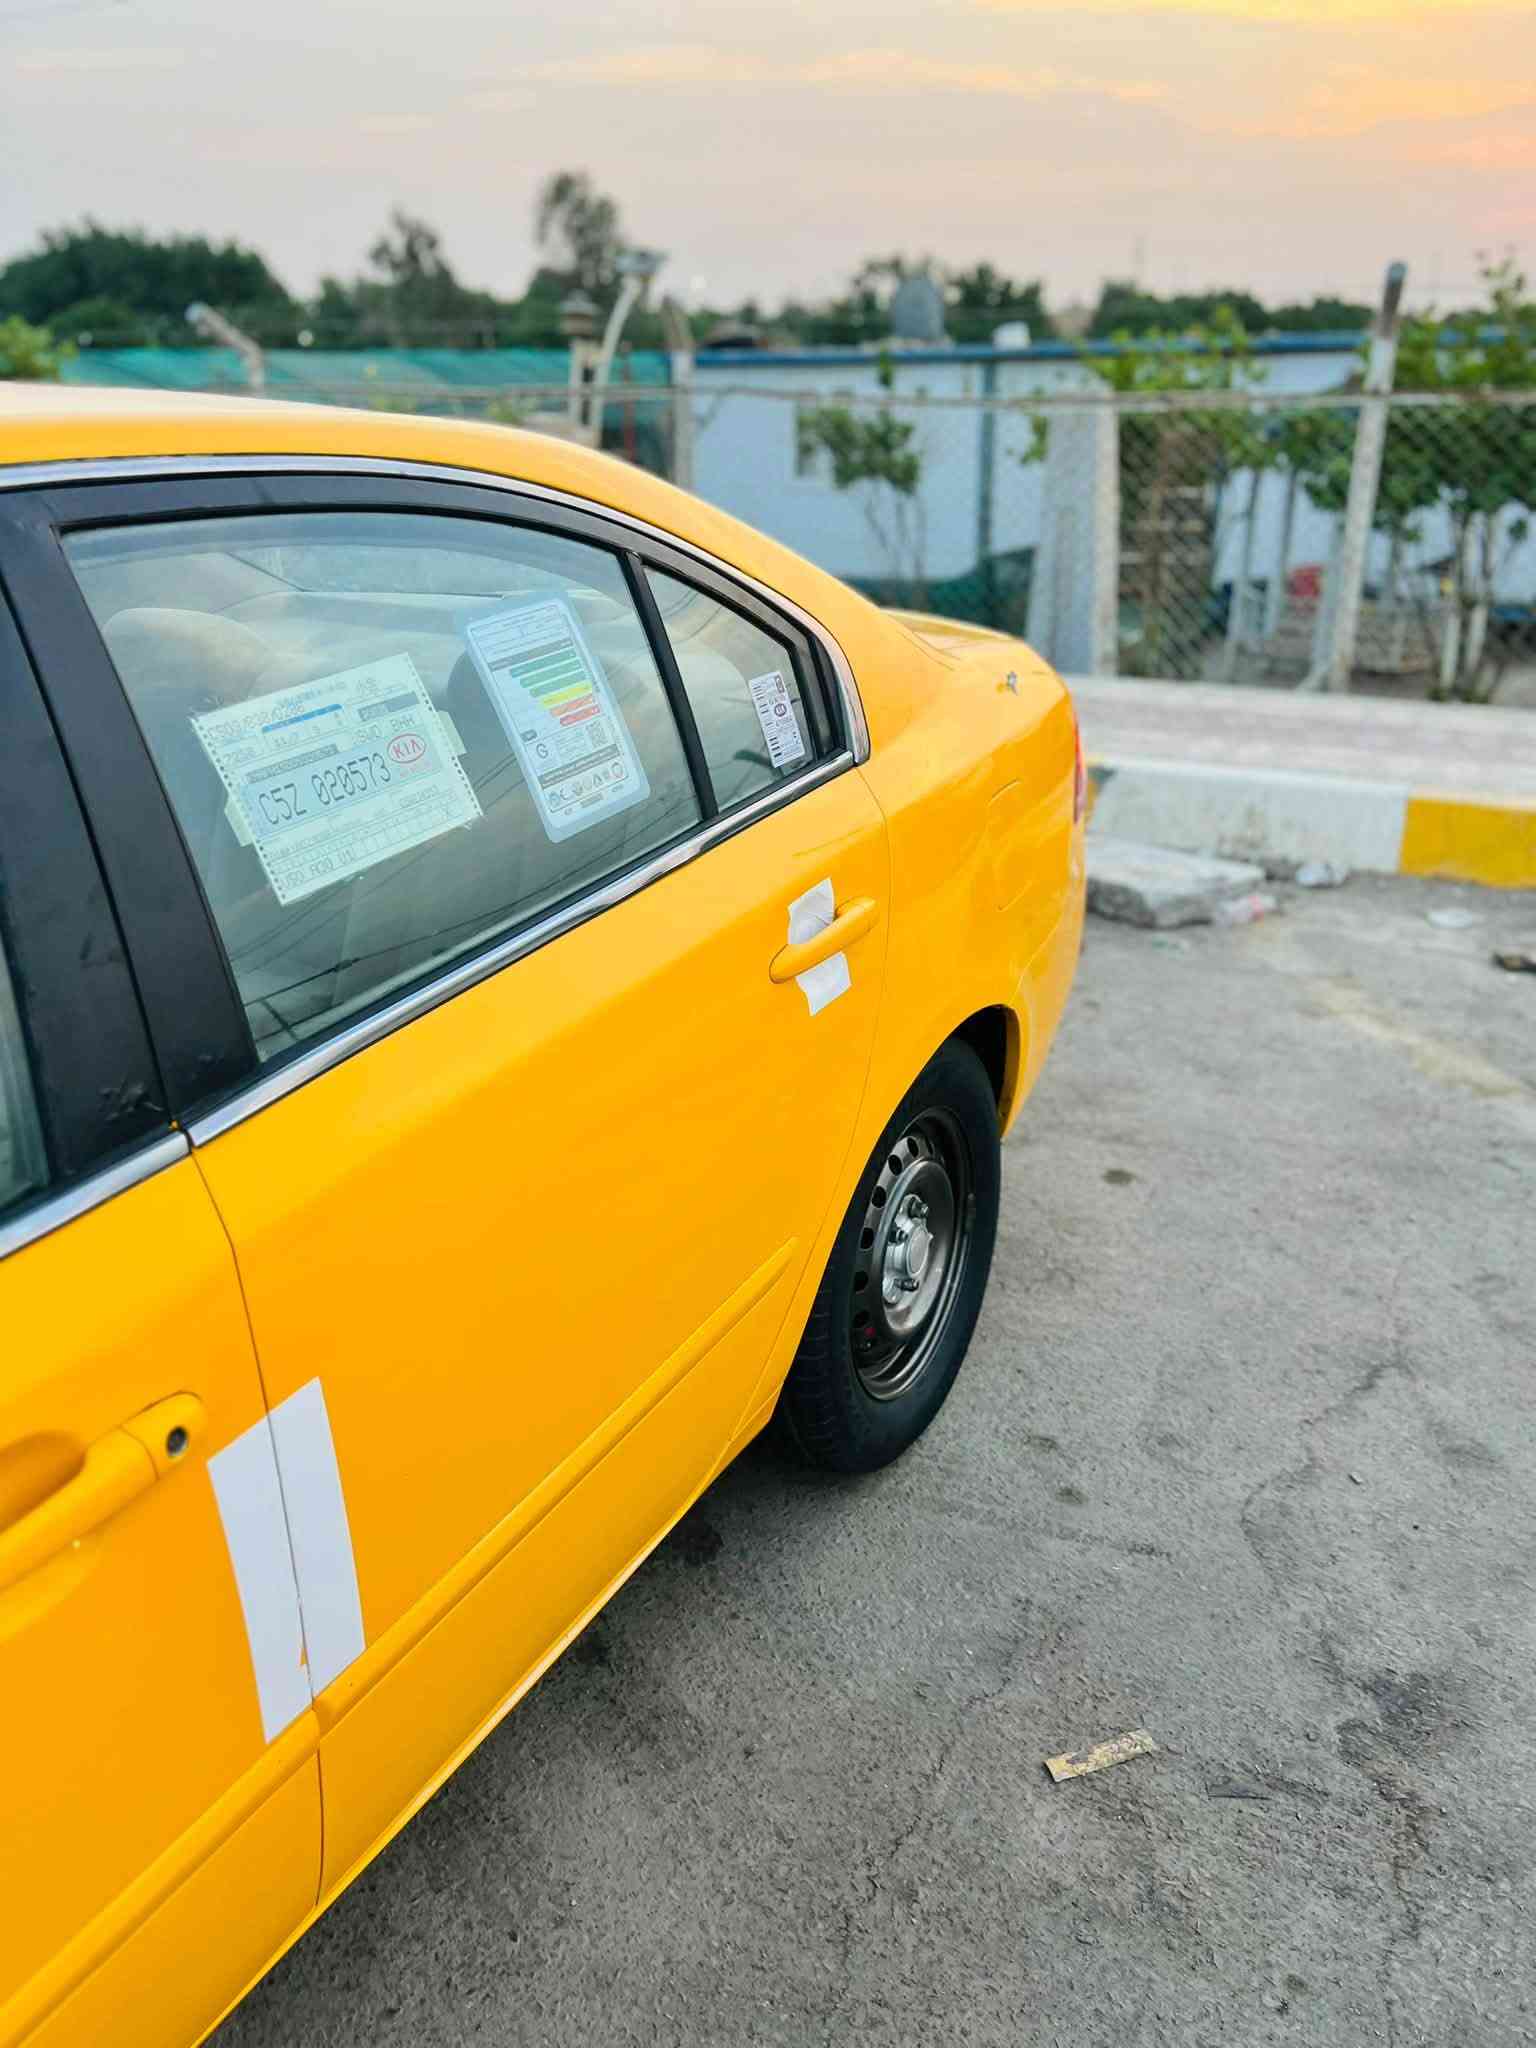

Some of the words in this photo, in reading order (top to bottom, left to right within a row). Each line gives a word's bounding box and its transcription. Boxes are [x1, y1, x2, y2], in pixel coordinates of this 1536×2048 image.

[392, 739, 422, 759] KIA
[535, 743, 549, 759] G
[258, 783, 307, 825] C5Z
[311, 752, 391, 806] 020573
